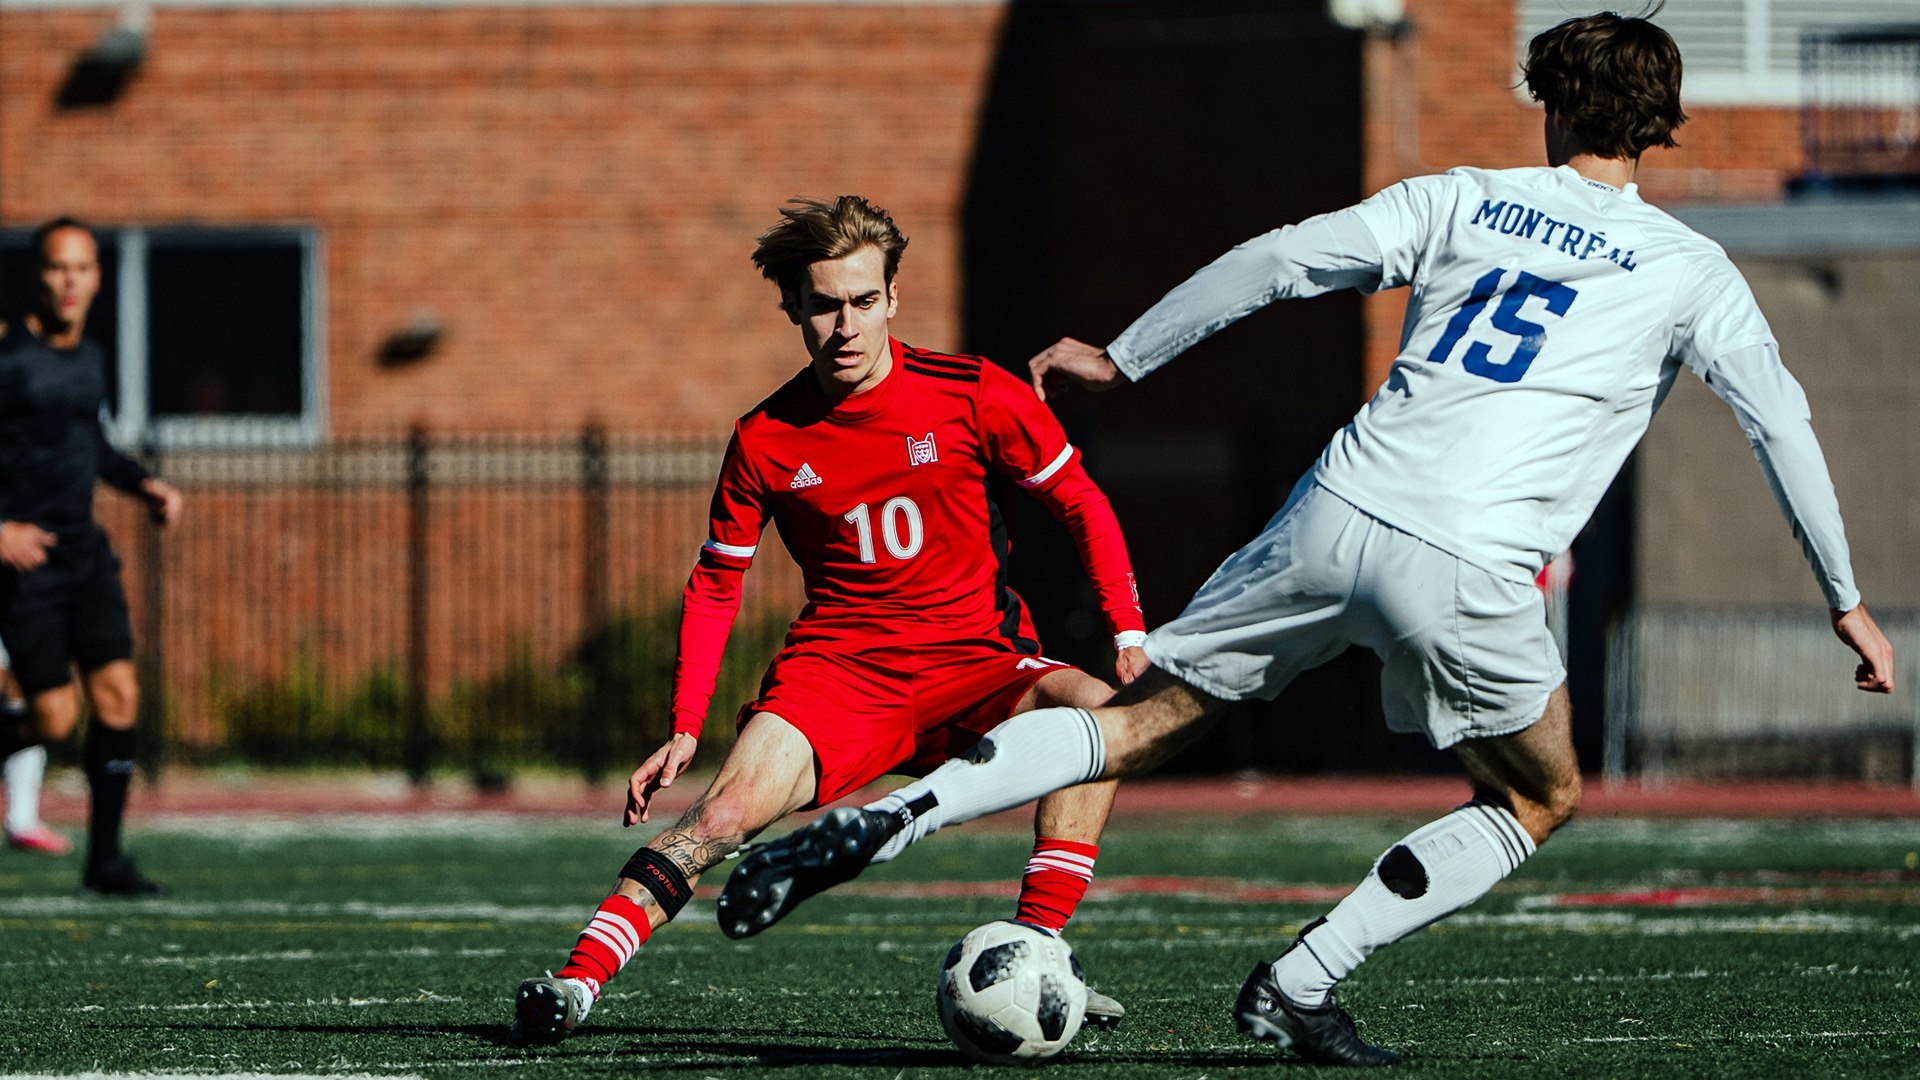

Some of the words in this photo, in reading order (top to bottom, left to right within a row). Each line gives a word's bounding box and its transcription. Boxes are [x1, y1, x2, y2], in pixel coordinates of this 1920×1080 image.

[1427, 267, 1579, 383] 15
[790, 476, 823, 489] adidas
[844, 496, 924, 564] 10
